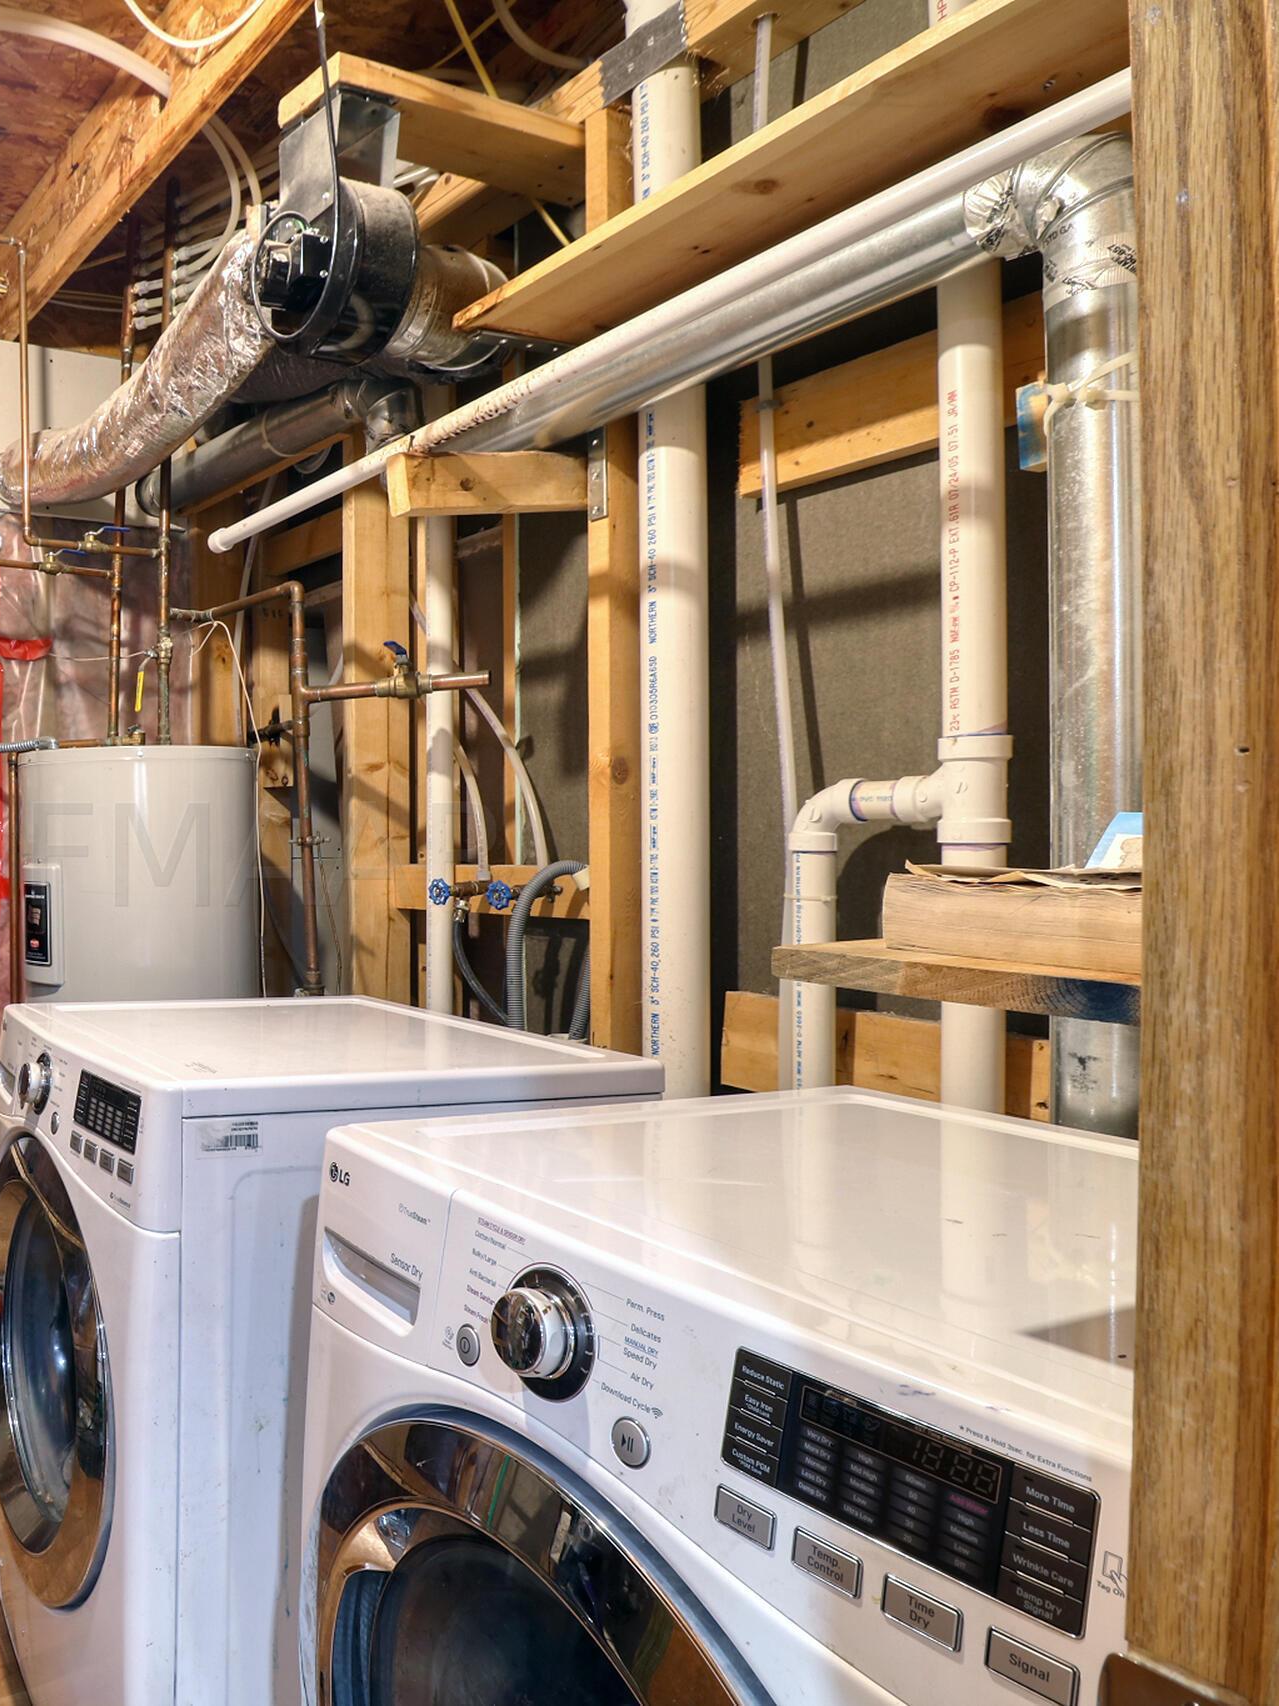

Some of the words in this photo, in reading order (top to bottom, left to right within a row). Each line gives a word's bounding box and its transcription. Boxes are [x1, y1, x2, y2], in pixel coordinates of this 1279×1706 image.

[647, 512, 657, 526] PSI
[646, 528, 657, 546] 260
[647, 600, 658, 645] NORTHERN
[948, 649, 960, 683] D-1785
[949, 687, 960, 710] ASTM
[650, 926, 660, 940] PSI
[650, 1014, 660, 1057] NORTHERN
[391, 1253, 410, 1273] Sensor
[411, 1265, 424, 1281] Dry
[626, 1298, 645, 1313] Perm.
[646, 1307, 665, 1321] Press
[631, 1323, 661, 1344] Delicates
[624, 1336, 647, 1352] MANUAL
[647, 1346, 658, 1356] DRY
[623, 1347, 645, 1364] Speed
[645, 1357, 658, 1370] Dry
[630, 1372, 641, 1382] Air
[641, 1378, 655, 1391] Dry
[766, 1375, 785, 1390] Static
[601, 1382, 632, 1405] Download
[632, 1398, 651, 1414] Cycle
[745, 1394, 760, 1408] Easy
[760, 1401, 774, 1413] Iron
[734, 1422, 756, 1439] Energy
[756, 1432, 775, 1447] Saver
[732, 1448, 755, 1465] Custom
[756, 1460, 771, 1474] PGM
[966, 1427, 983, 1440] Press
[991, 1438, 1007, 1448] Hold
[1026, 1450, 1037, 1460] for
[1037, 1455, 1056, 1469] Extra
[1057, 1462, 1093, 1482] Functions
[801, 1468, 815, 1481] Less
[863, 1468, 878, 1482] High
[798, 1481, 815, 1496] Damp
[1025, 1486, 1050, 1503] More
[1052, 1497, 1076, 1514] Time
[737, 1504, 754, 1521] Dry
[843, 1503, 859, 1517] Ultra
[731, 1513, 757, 1535] Level
[1022, 1521, 1045, 1538] Less
[1047, 1531, 1071, 1549] Time
[811, 1545, 840, 1571] Temp.
[807, 1556, 844, 1584] Control
[1012, 1553, 1050, 1578] Wrinkle
[1051, 1570, 1075, 1588] Care
[1016, 1586, 1043, 1607] Damp
[1044, 1597, 1063, 1616] Dry
[1096, 1580, 1111, 1593] Tag
[1112, 1587, 1126, 1599] On
[906, 1593, 936, 1618] Time
[1023, 1600, 1054, 1621] Signal
[909, 1609, 932, 1629] Dry
[1008, 1653, 1051, 1684] Signal
